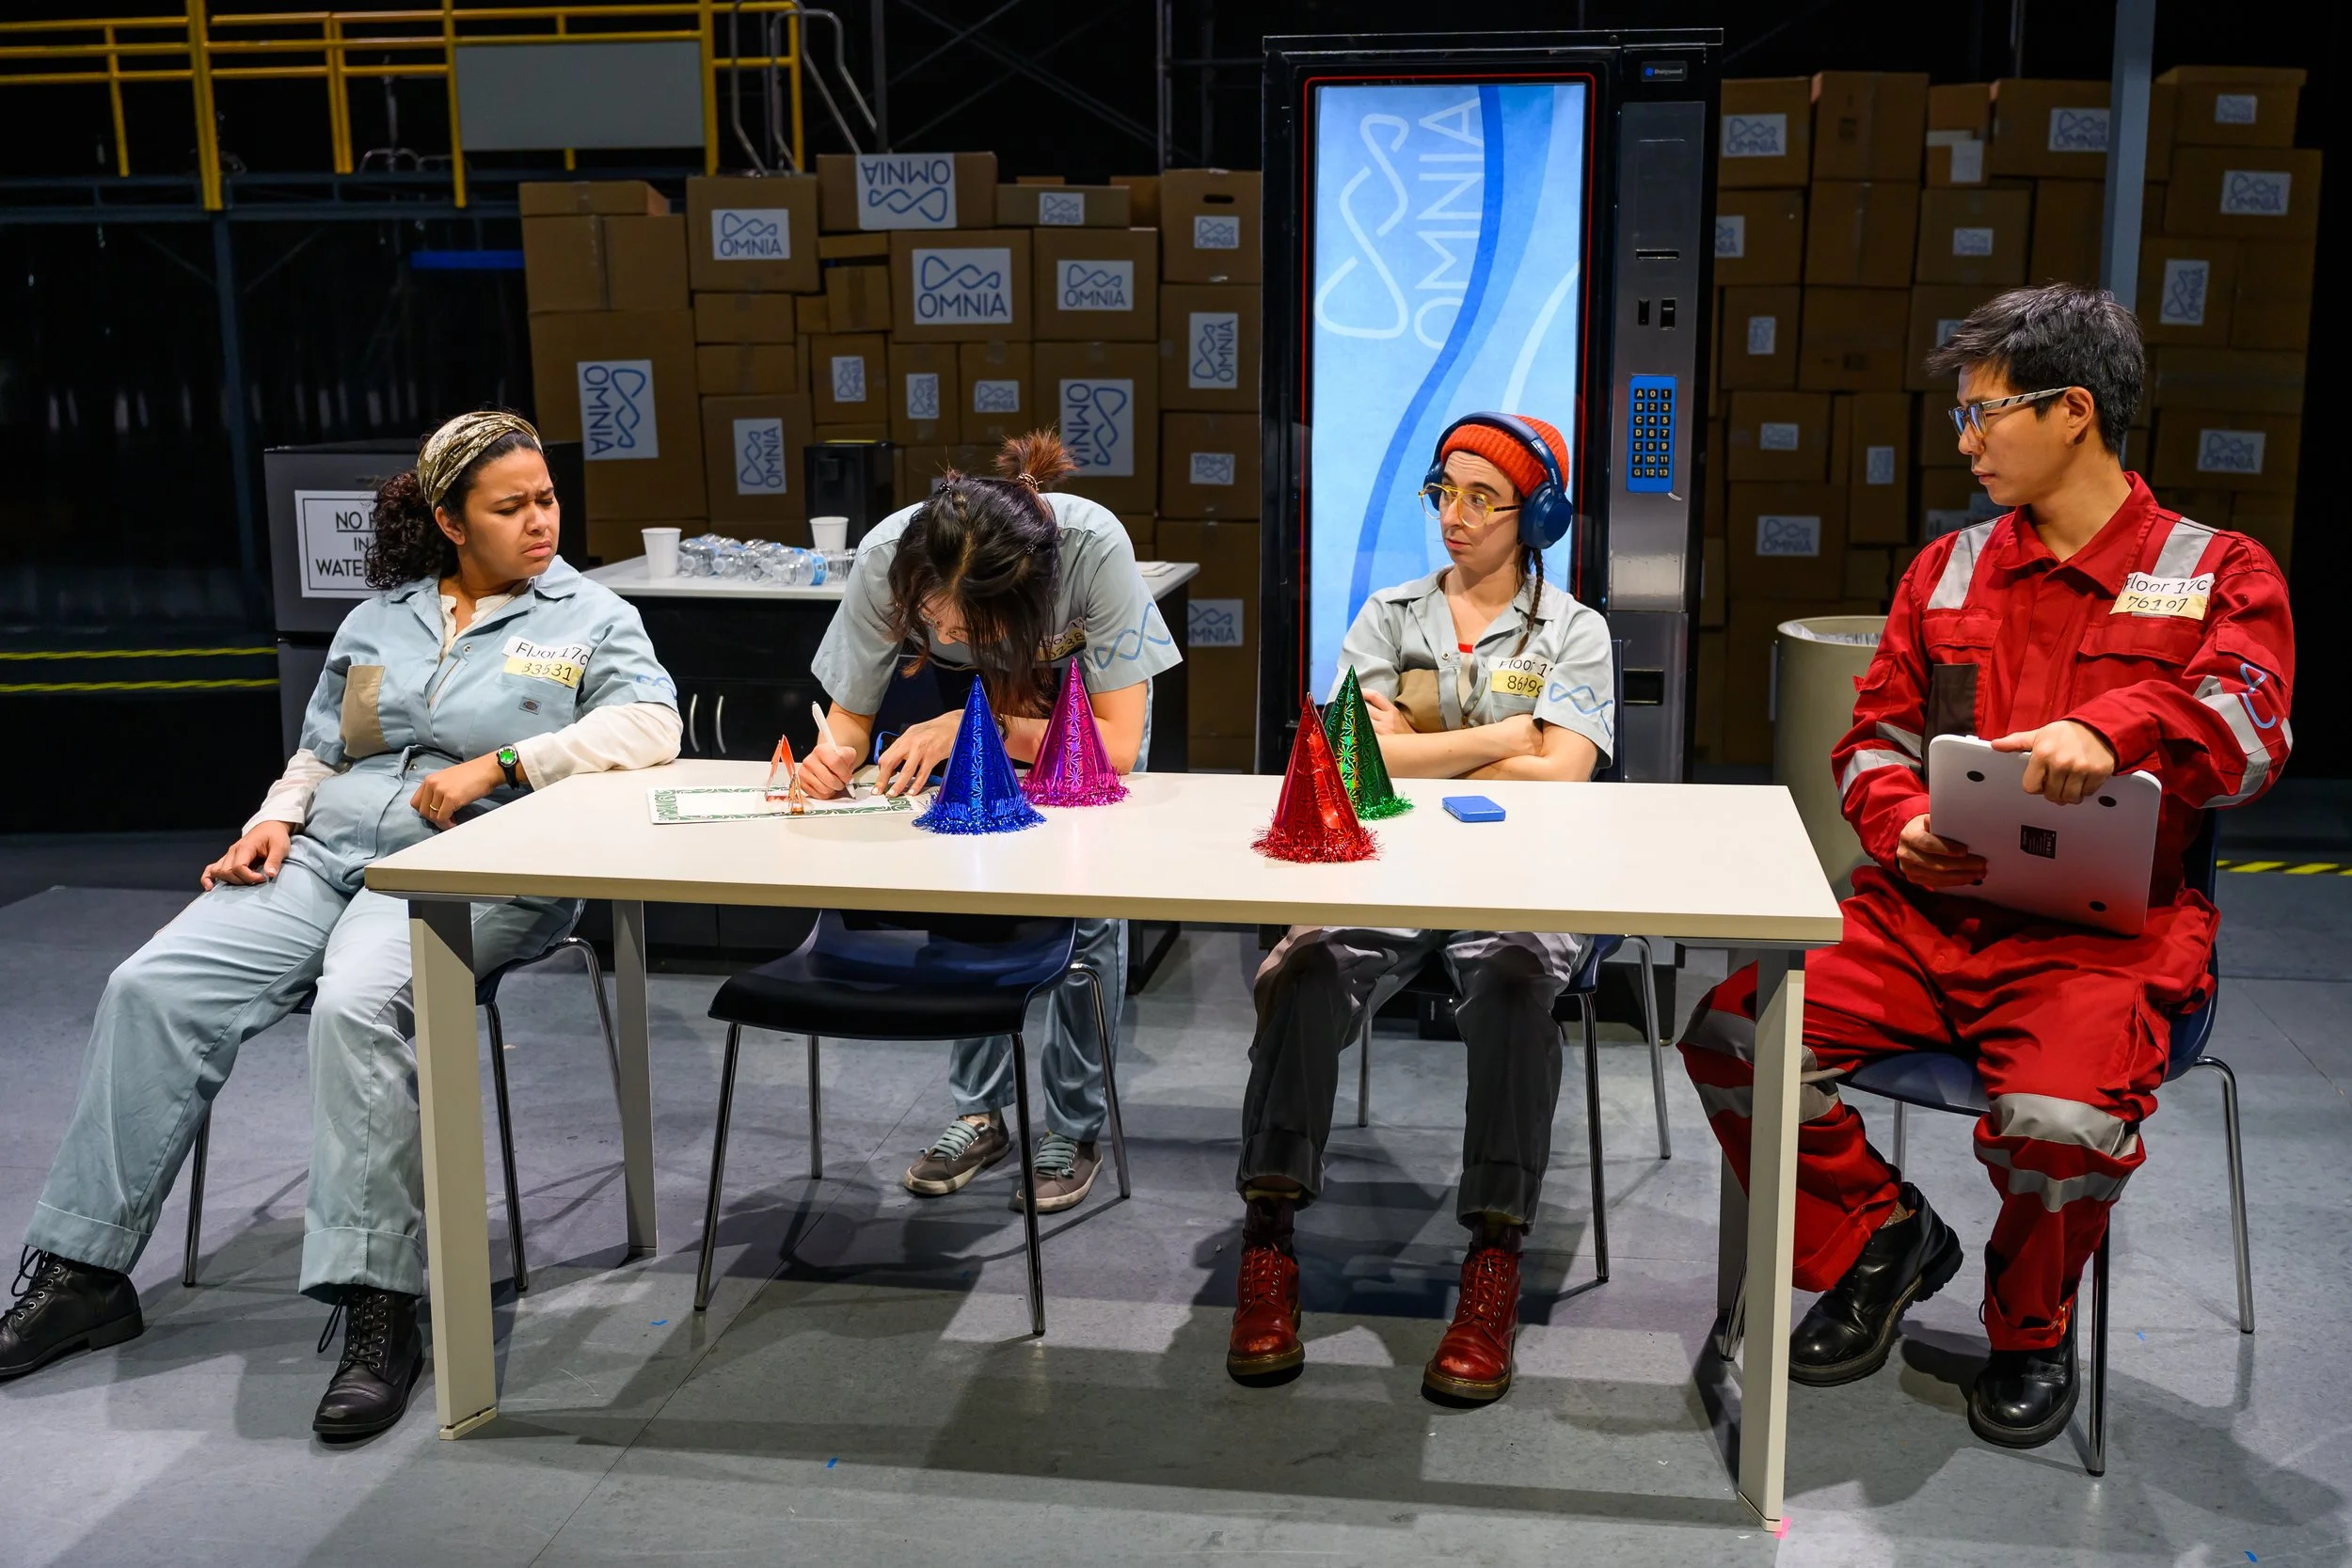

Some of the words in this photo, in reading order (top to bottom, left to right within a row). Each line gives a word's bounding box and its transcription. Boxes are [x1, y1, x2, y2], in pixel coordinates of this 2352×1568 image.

[860, 159, 951, 186] OMNIA
[1413, 97, 1486, 351] OMNIA
[719, 238, 783, 257] OMNIA
[917, 293, 1009, 319] OMNIA
[1064, 289, 1127, 308] OMNIA
[1216, 320, 1235, 383] OMNIA
[583, 365, 613, 457] OMNIA
[763, 425, 784, 488] OMNIA
[335, 511, 363, 530] NO
[353, 536, 370, 551] IN
[2126, 595, 2189, 612] 76197
[1187, 626, 1236, 643] MNIA
[520, 661, 573, 683] 33531
